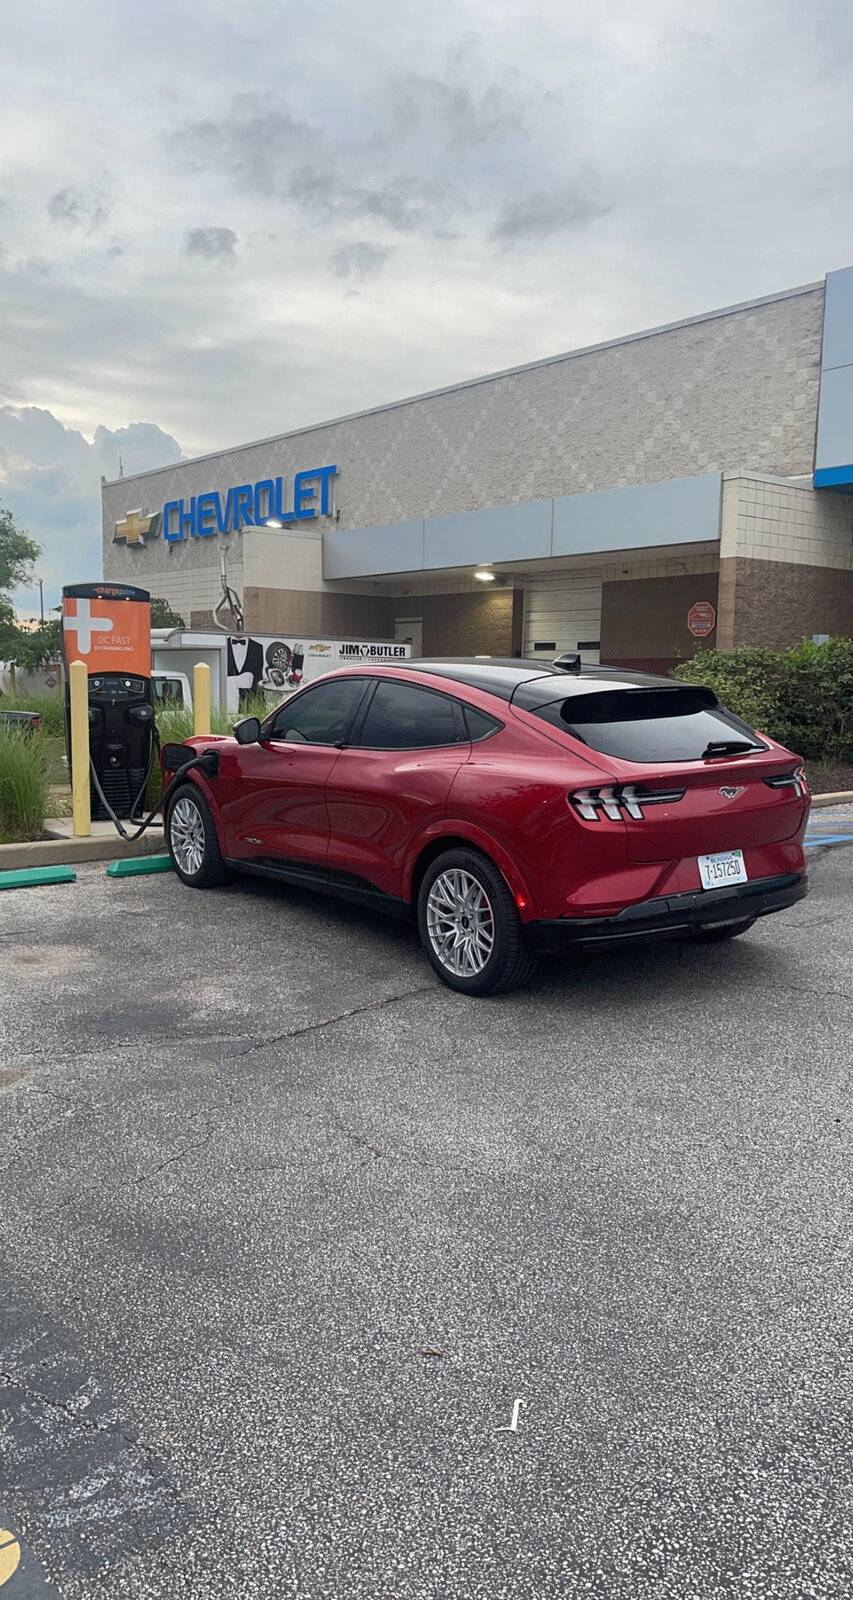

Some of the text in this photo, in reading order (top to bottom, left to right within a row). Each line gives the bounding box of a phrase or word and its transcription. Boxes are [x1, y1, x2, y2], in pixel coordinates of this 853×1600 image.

[163, 464, 338, 543] CHEVROLET
[97, 636, 131, 645] DC FAST
[339, 644, 406, 657] JIM BUTLER
